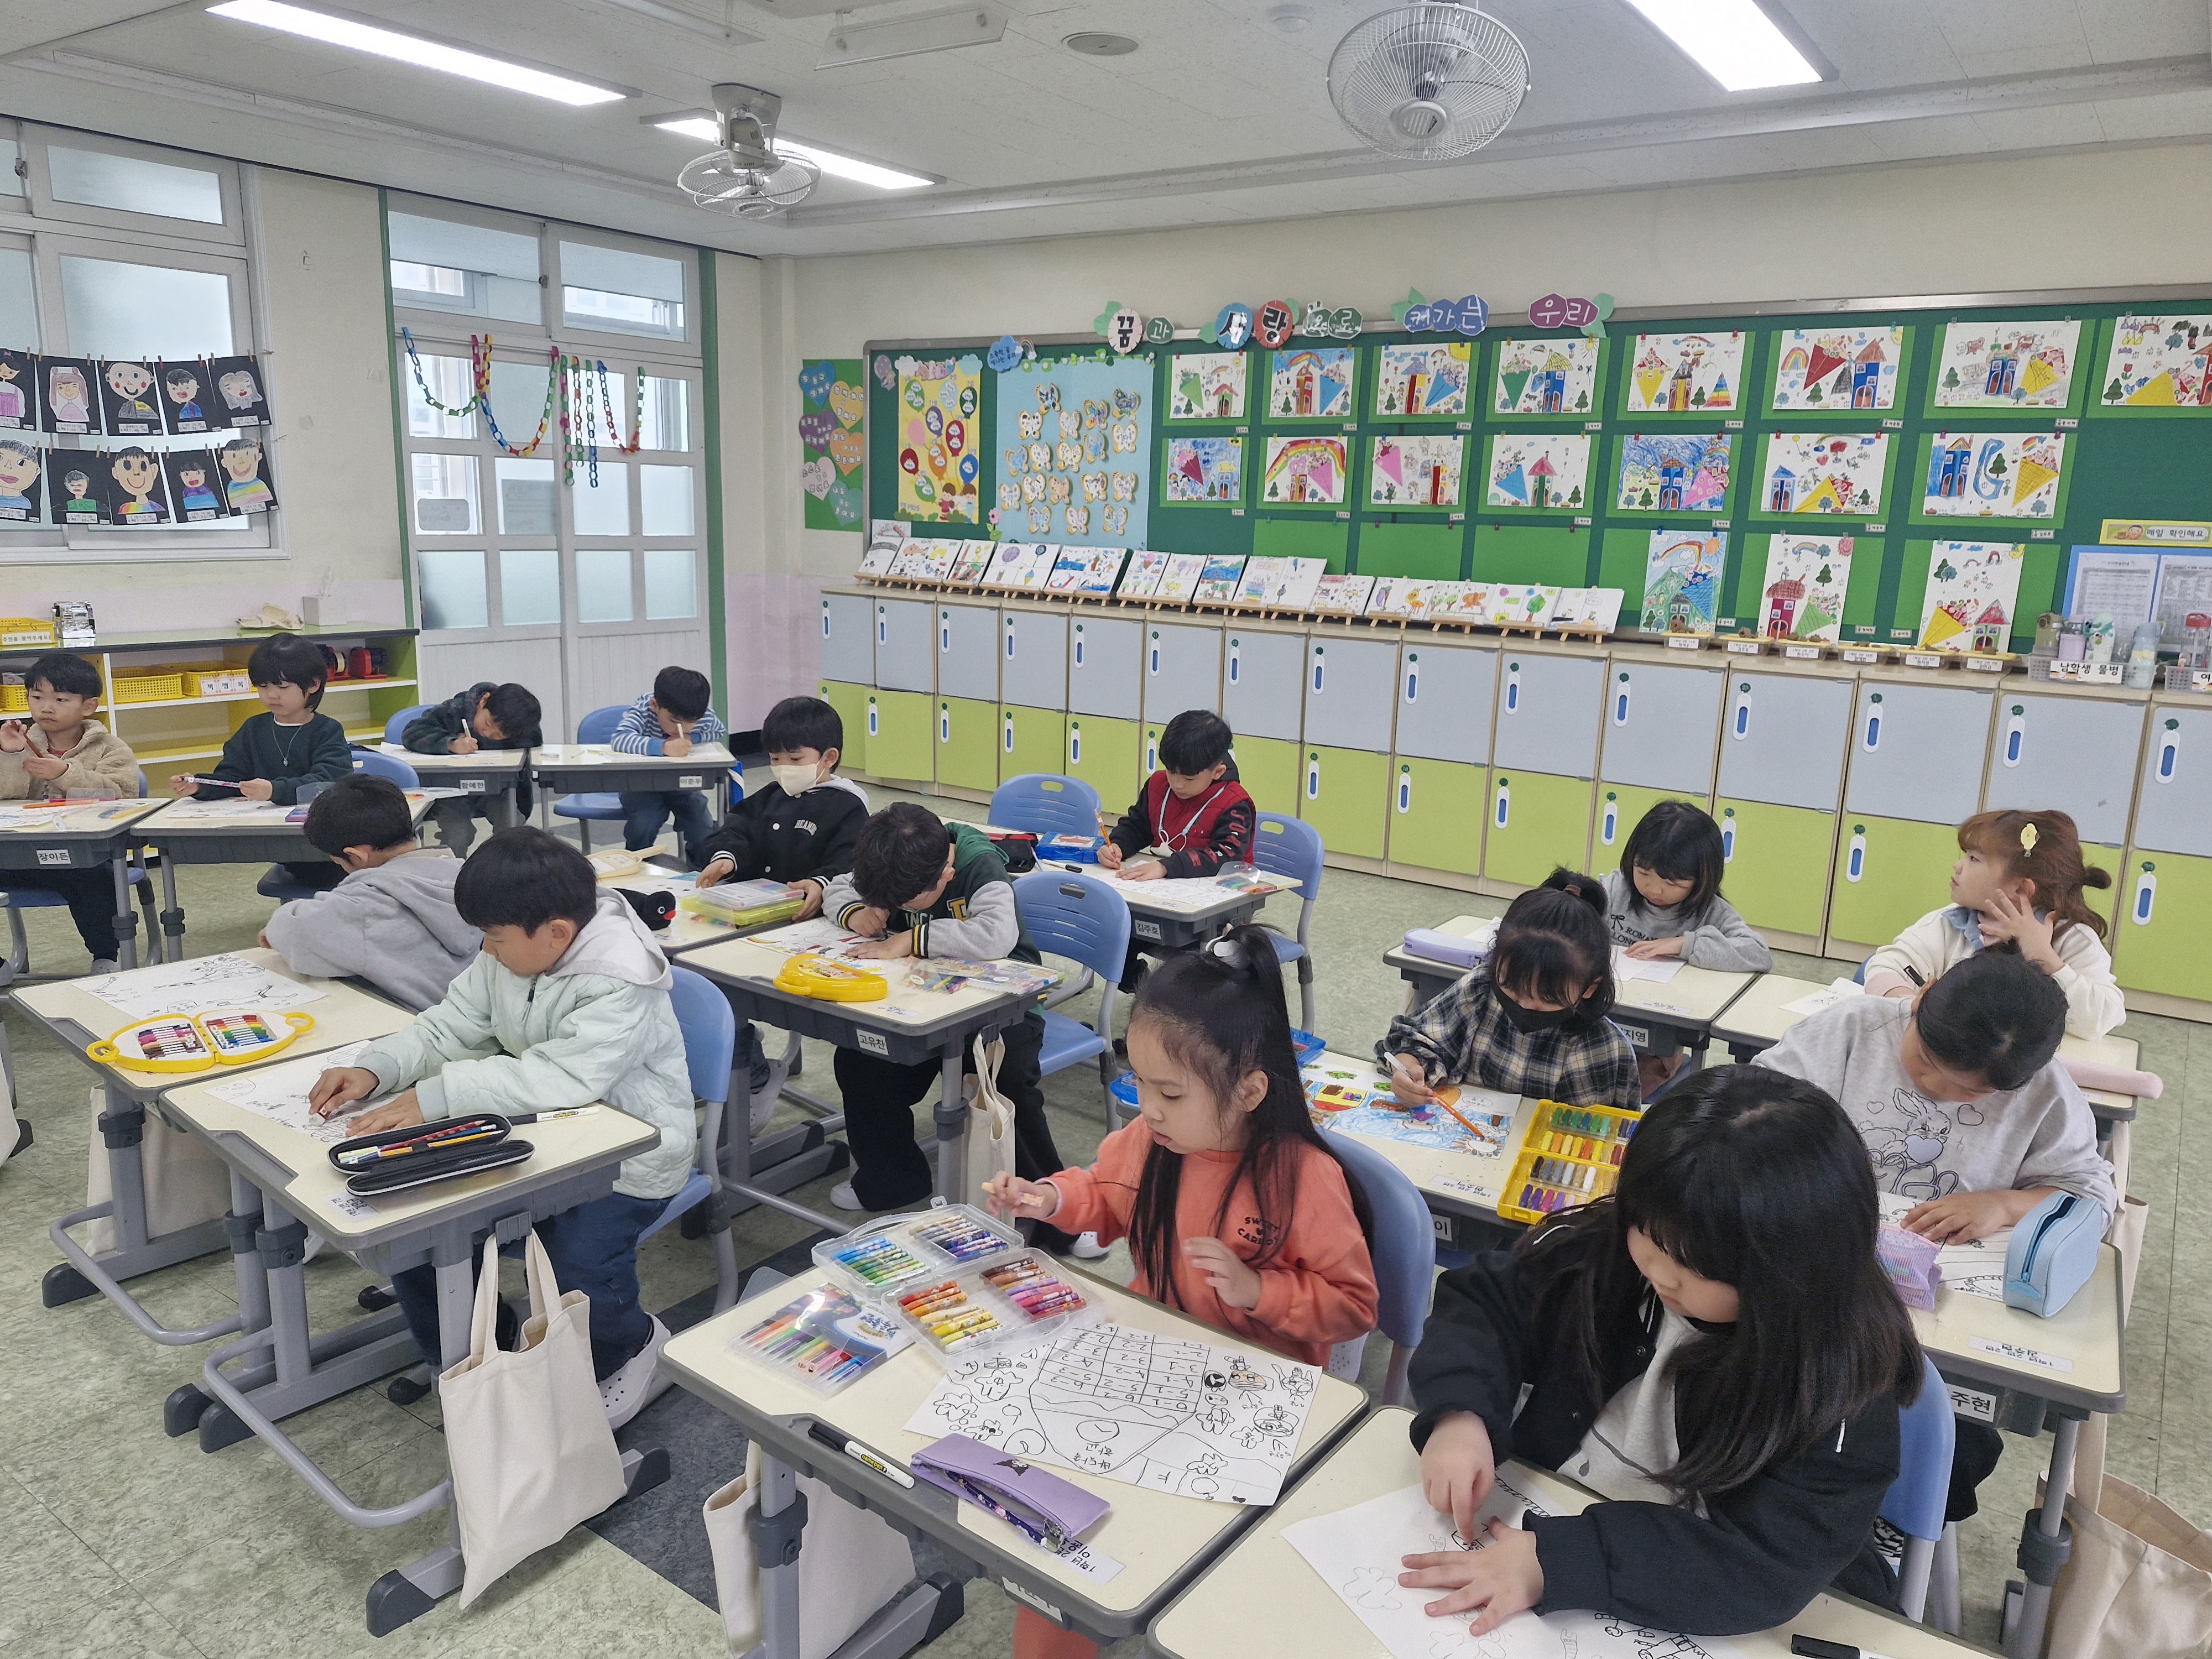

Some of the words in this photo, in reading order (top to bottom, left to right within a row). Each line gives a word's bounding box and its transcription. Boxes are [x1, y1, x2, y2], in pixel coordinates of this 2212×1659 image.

[1537, 299, 1590, 325] 우리
[2146, 529, 2163, 537] 매일
[2060, 662, 2091, 674] 남학생
[38, 852, 69, 861] 장이든
[1136, 922, 1159, 935] 김주호
[859, 1034, 885, 1050] 고유찬
[1078, 1333, 1108, 1344] 2-3
[1073, 1342, 1101, 1356] 3-3
[1122, 1340, 1147, 1351] 2-2
[1062, 1354, 1093, 1368] 4-3
[1121, 1353, 1146, 1365] 3-2
[1113, 1366, 1145, 1379] 4-2
[1168, 1361, 1198, 1373] 3-1
[1059, 1367, 1092, 1381] 5-3
[1051, 1376, 1083, 1390] 6-3
[1104, 1379, 1138, 1391] 5-2
[1166, 1376, 1194, 1388] 4-1
[1104, 1392, 1134, 1402] 6-2
[1154, 1386, 1189, 1399] 5-1
[1947, 1390, 1991, 1415] 주현
[1071, 1555, 1096, 1573] 1학년
